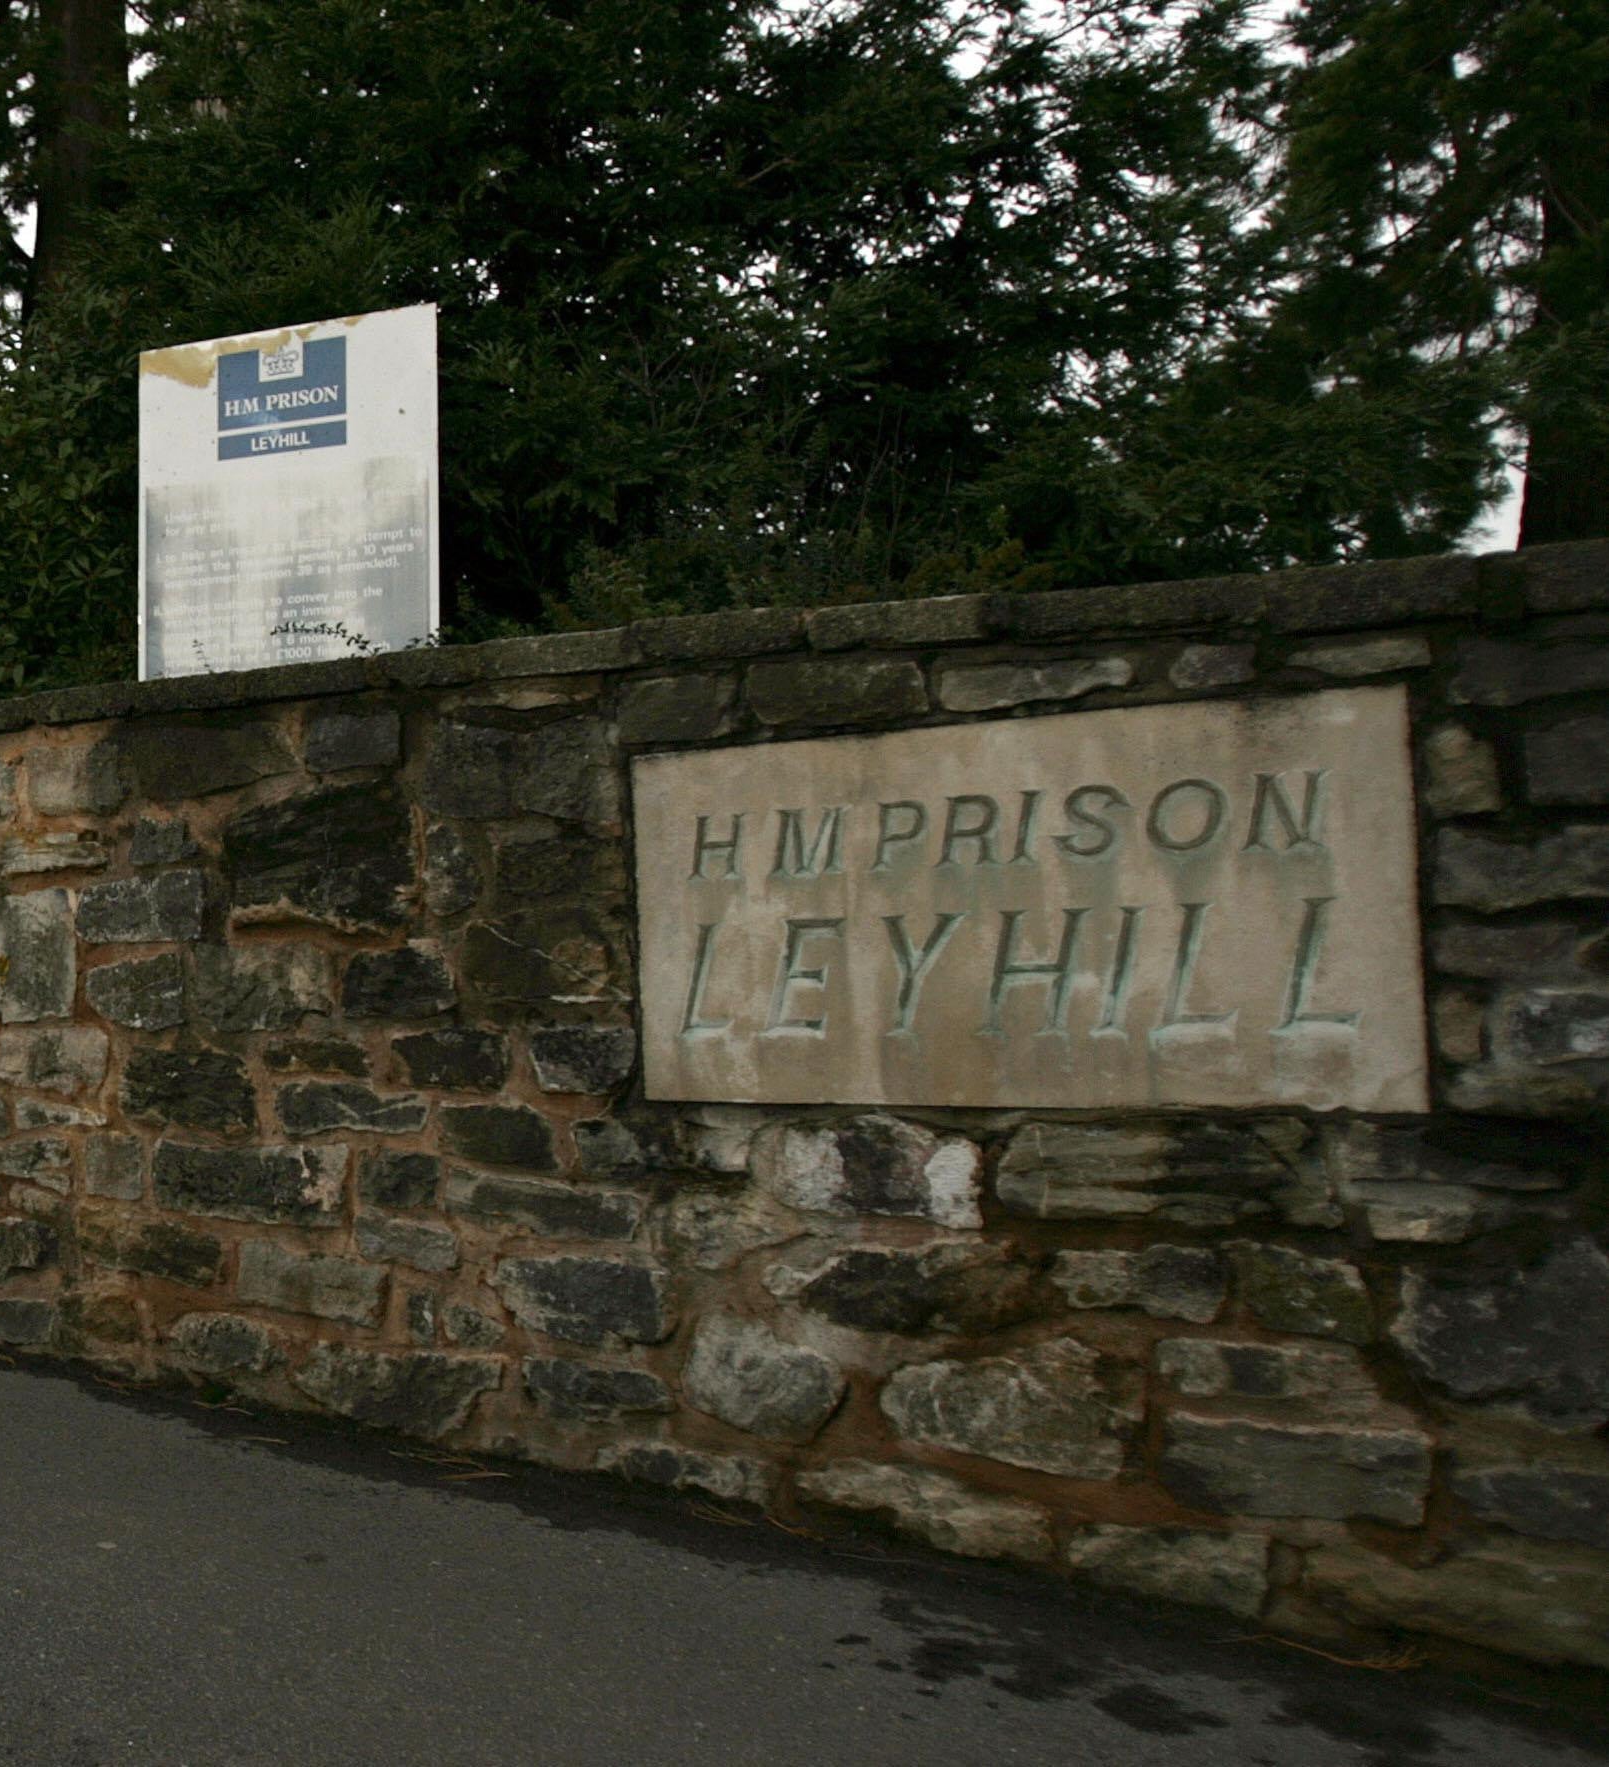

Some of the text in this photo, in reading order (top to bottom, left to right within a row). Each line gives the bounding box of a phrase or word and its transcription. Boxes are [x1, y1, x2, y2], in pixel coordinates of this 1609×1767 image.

[224, 385, 339, 417] HM PRISON
[251, 431, 310, 452] LEYHILL
[355, 528, 404, 543] attempt
[410, 527, 423, 538] to
[298, 550, 342, 564] penalty
[364, 543, 377, 556] 10
[381, 541, 415, 556] years
[270, 596, 283, 607] to
[287, 591, 329, 604] convey
[334, 589, 358, 600] into
[363, 585, 384, 597] the
[870, 768, 1330, 871] PRISON
[678, 896, 1362, 1041] LEYHILL
